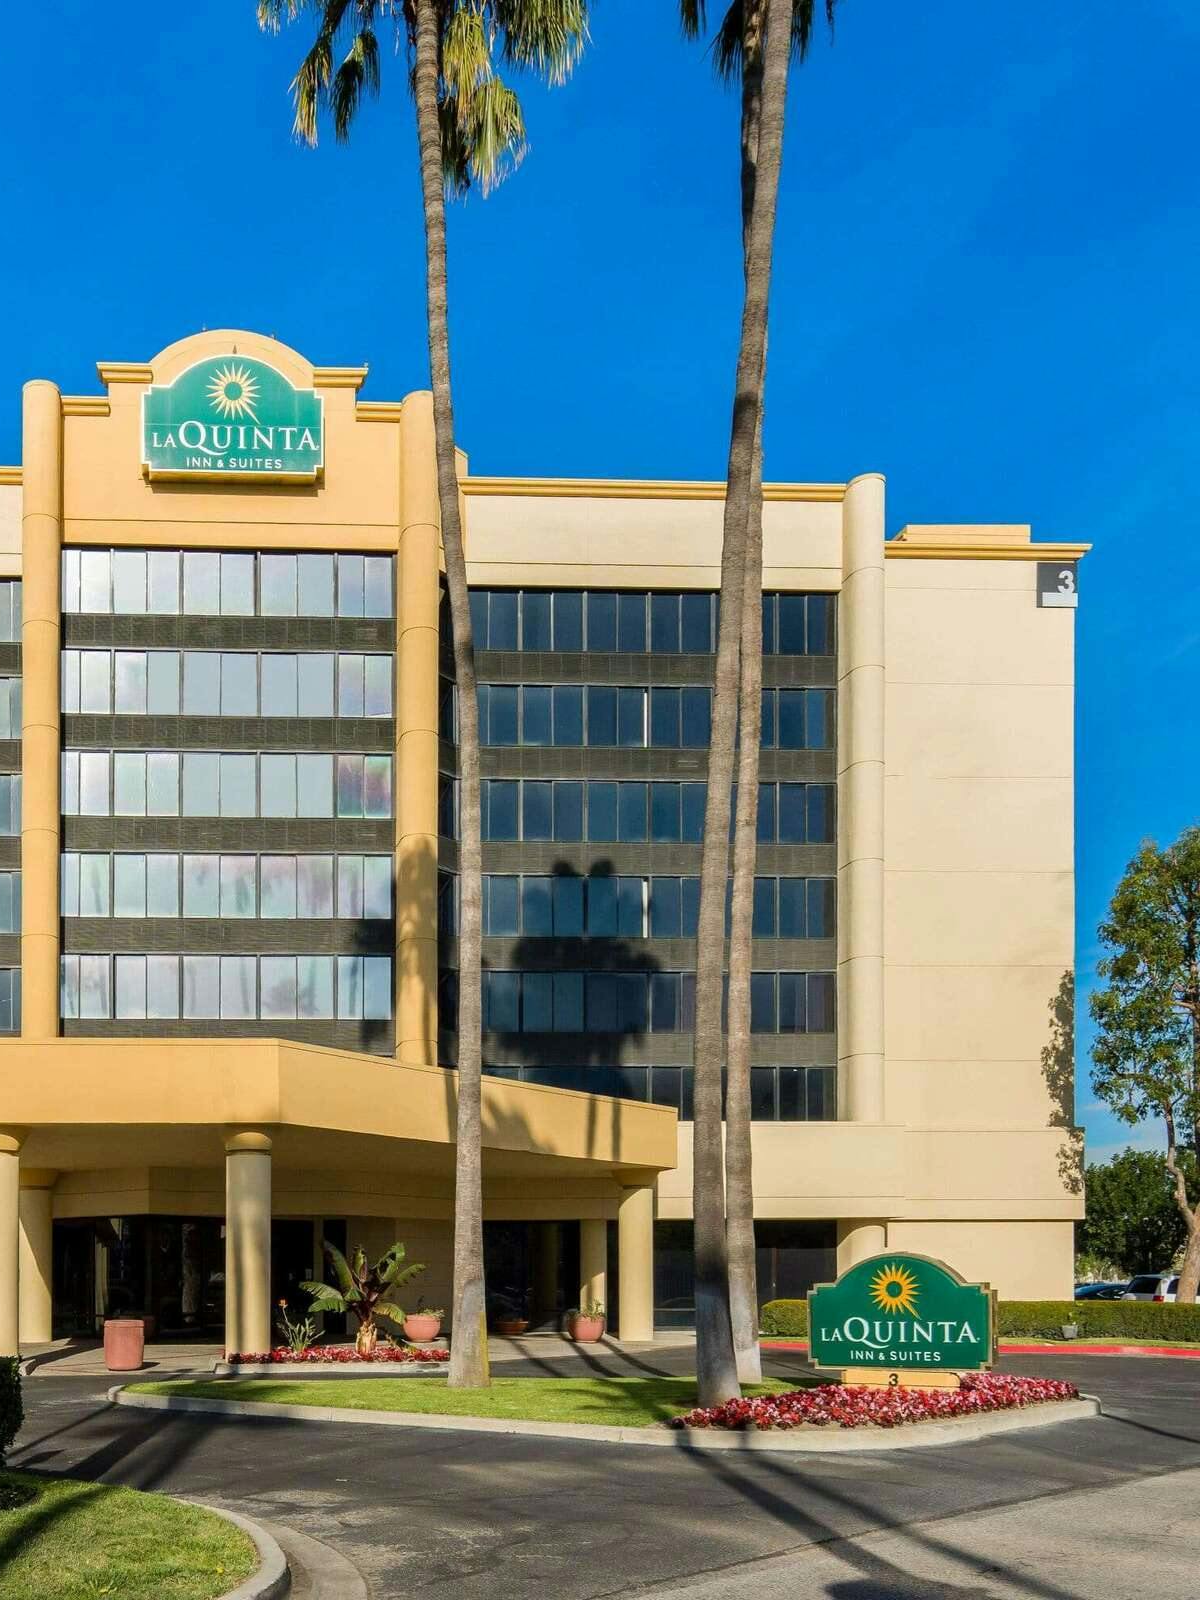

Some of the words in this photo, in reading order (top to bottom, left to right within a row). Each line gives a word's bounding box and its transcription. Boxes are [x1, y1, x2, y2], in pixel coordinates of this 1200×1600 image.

[152, 432, 177, 448] LA
[178, 420, 316, 456] QUINTA
[186, 457, 212, 467] INN
[217, 459, 225, 468] &
[229, 457, 283, 469] SUITES
[1057, 570, 1075, 594] 3
[821, 1327, 844, 1342] LA
[843, 1316, 978, 1349] QUINTA
[850, 1350, 874, 1360] INN
[879, 1352, 885, 1360] &
[890, 1351, 941, 1361] SUITES
[888, 1373, 899, 1387] 3
